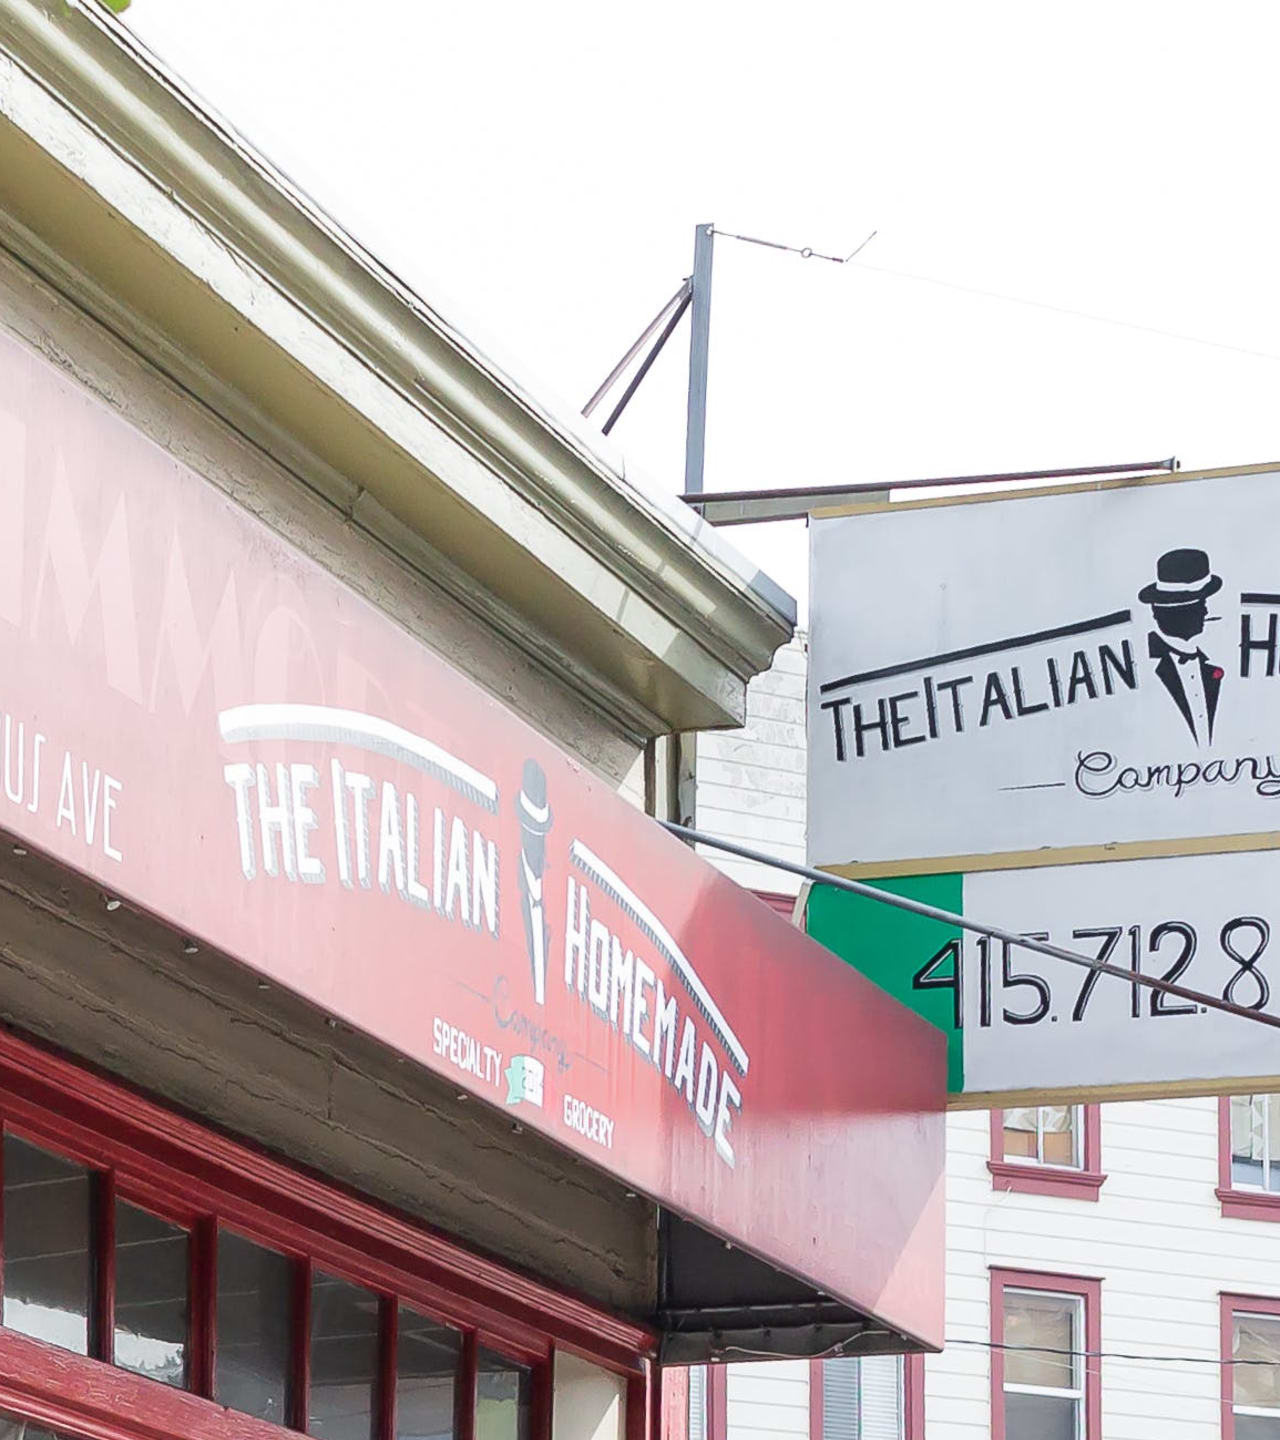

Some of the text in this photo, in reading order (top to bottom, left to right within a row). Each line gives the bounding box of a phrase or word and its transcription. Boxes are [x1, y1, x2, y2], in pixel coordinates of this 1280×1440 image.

[57, 751, 122, 862] AVE
[224, 758, 742, 1169] THE ITALIAN HOMEMADE
[433, 1017, 614, 1149] SPECIALTY GROCERY
